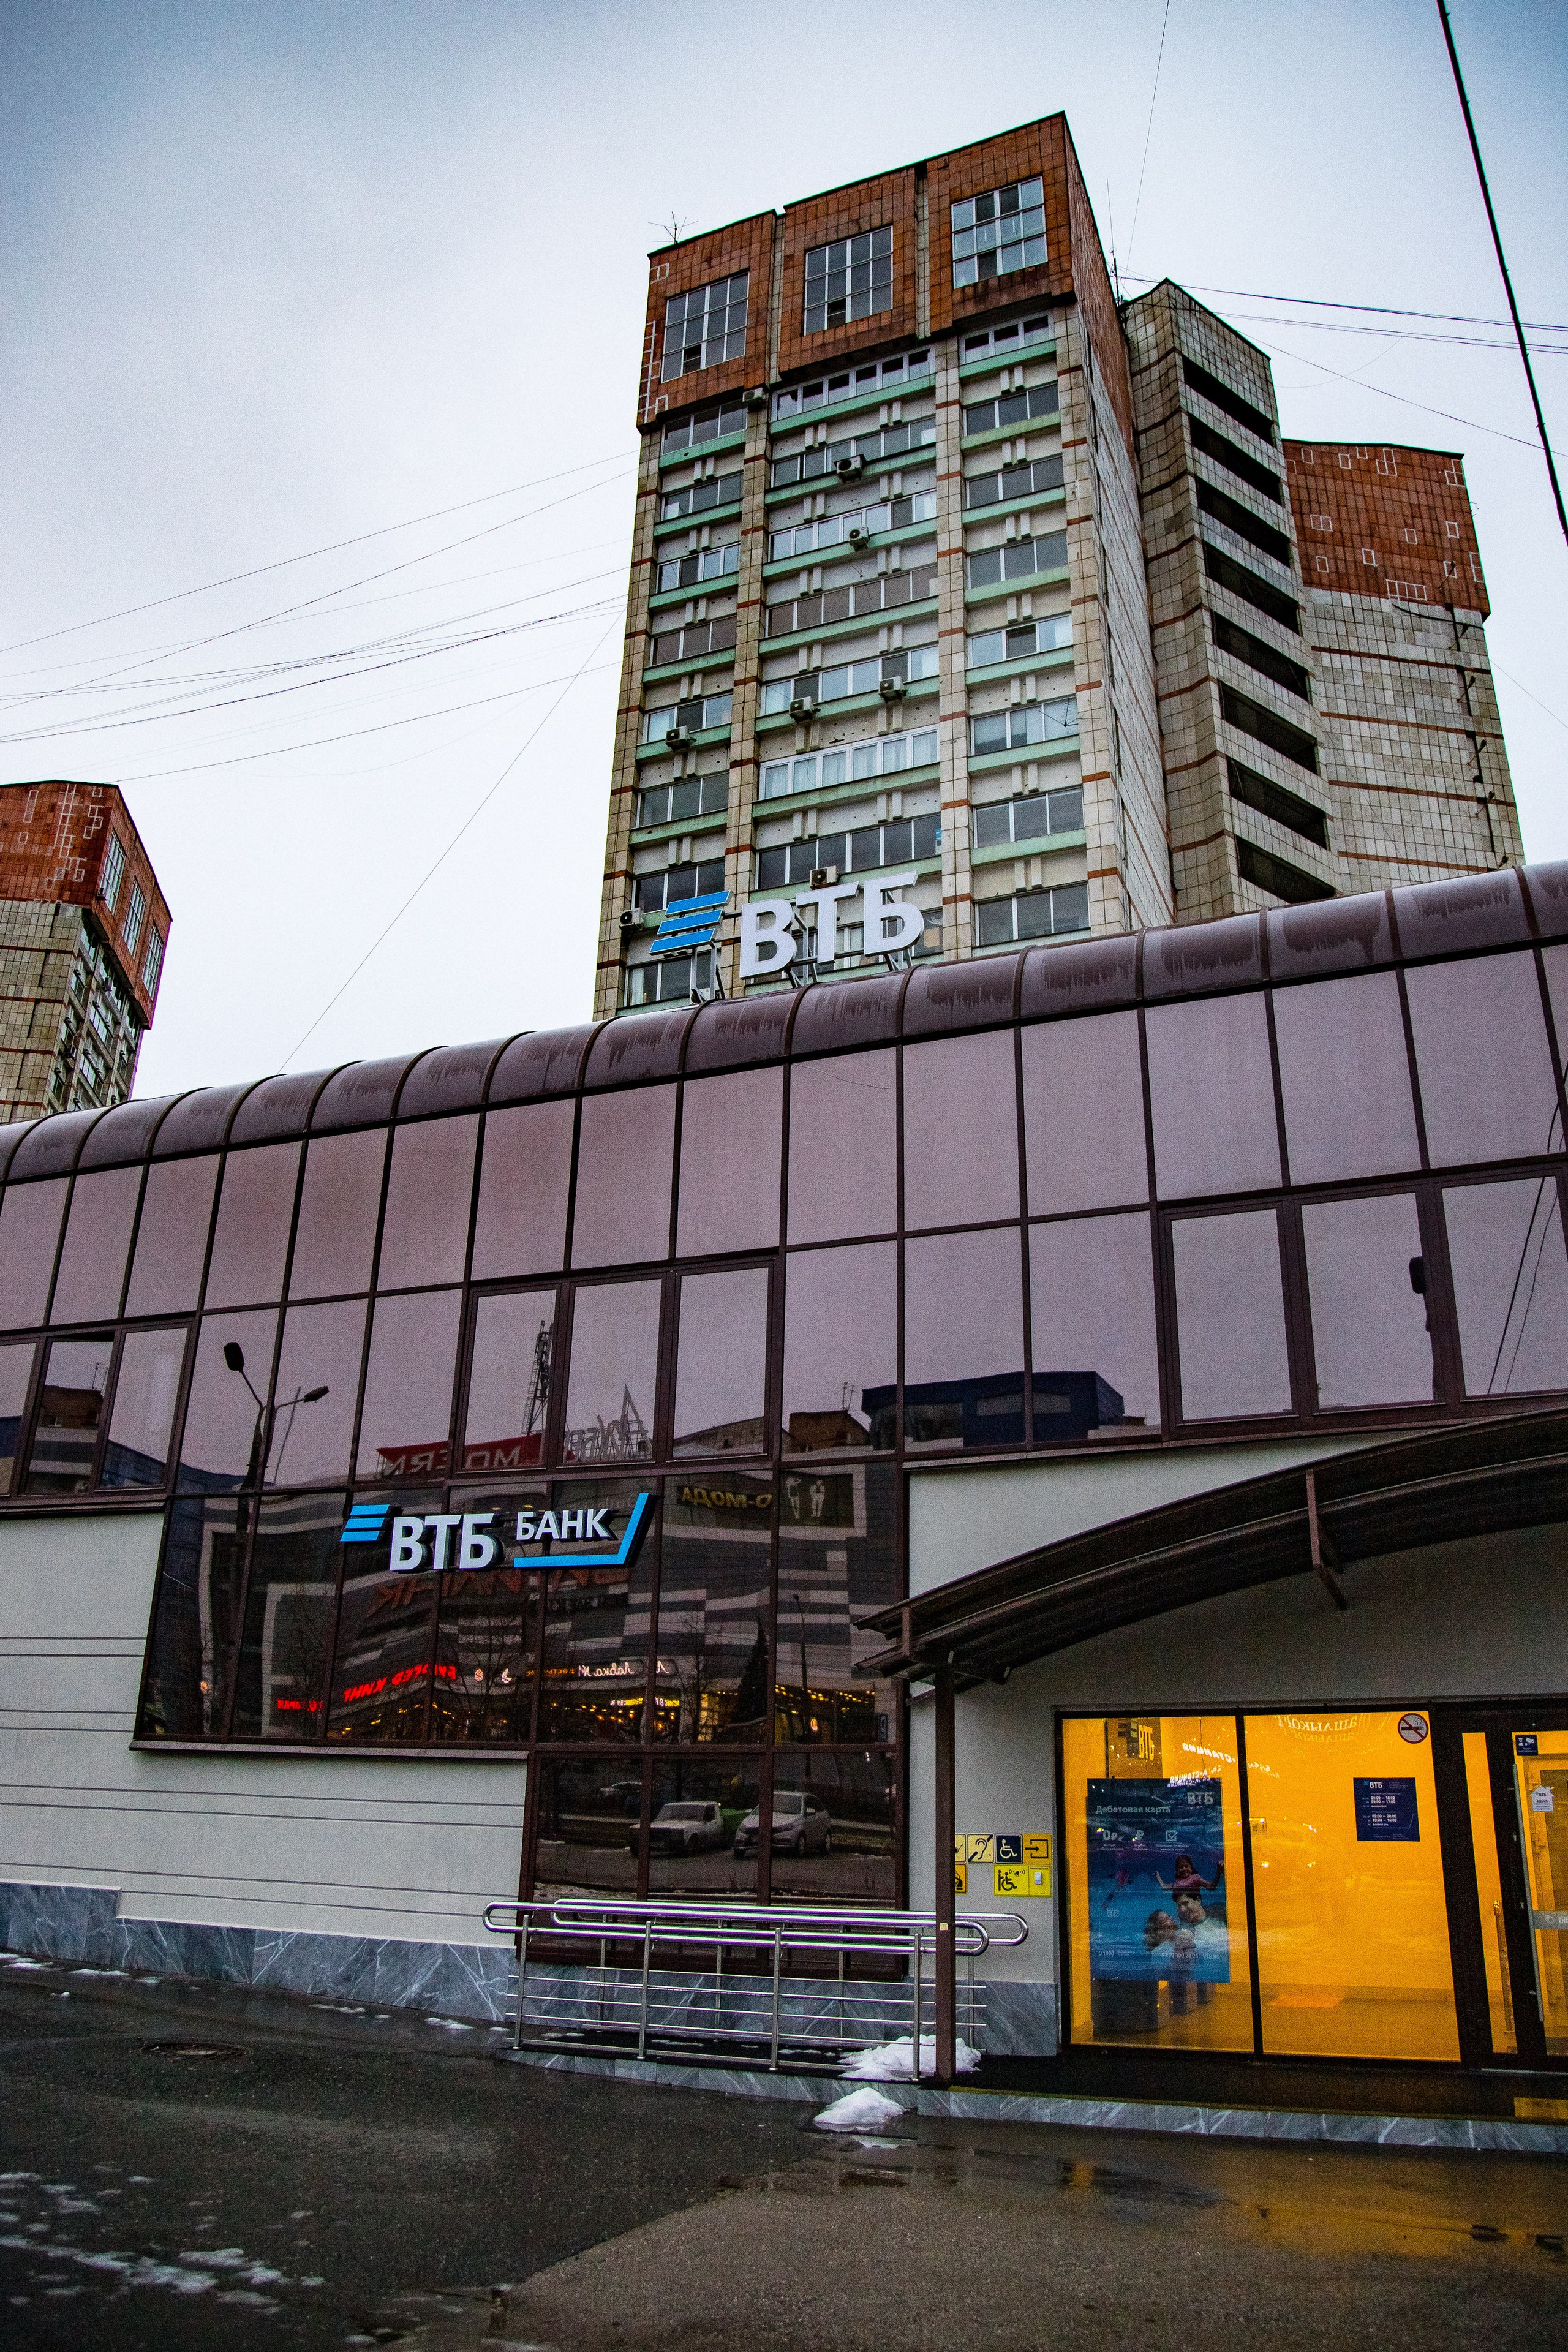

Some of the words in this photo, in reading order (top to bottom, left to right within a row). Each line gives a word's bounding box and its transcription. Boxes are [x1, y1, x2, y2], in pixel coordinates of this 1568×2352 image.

[739, 870, 924, 979] ВТБ
[389, 1513, 498, 1570] ВТБ
[516, 1507, 611, 1541] БАНК
[1095, 1805, 1144, 1814] Дебетовая
[1187, 1792, 1214, 1804] ВТБ
